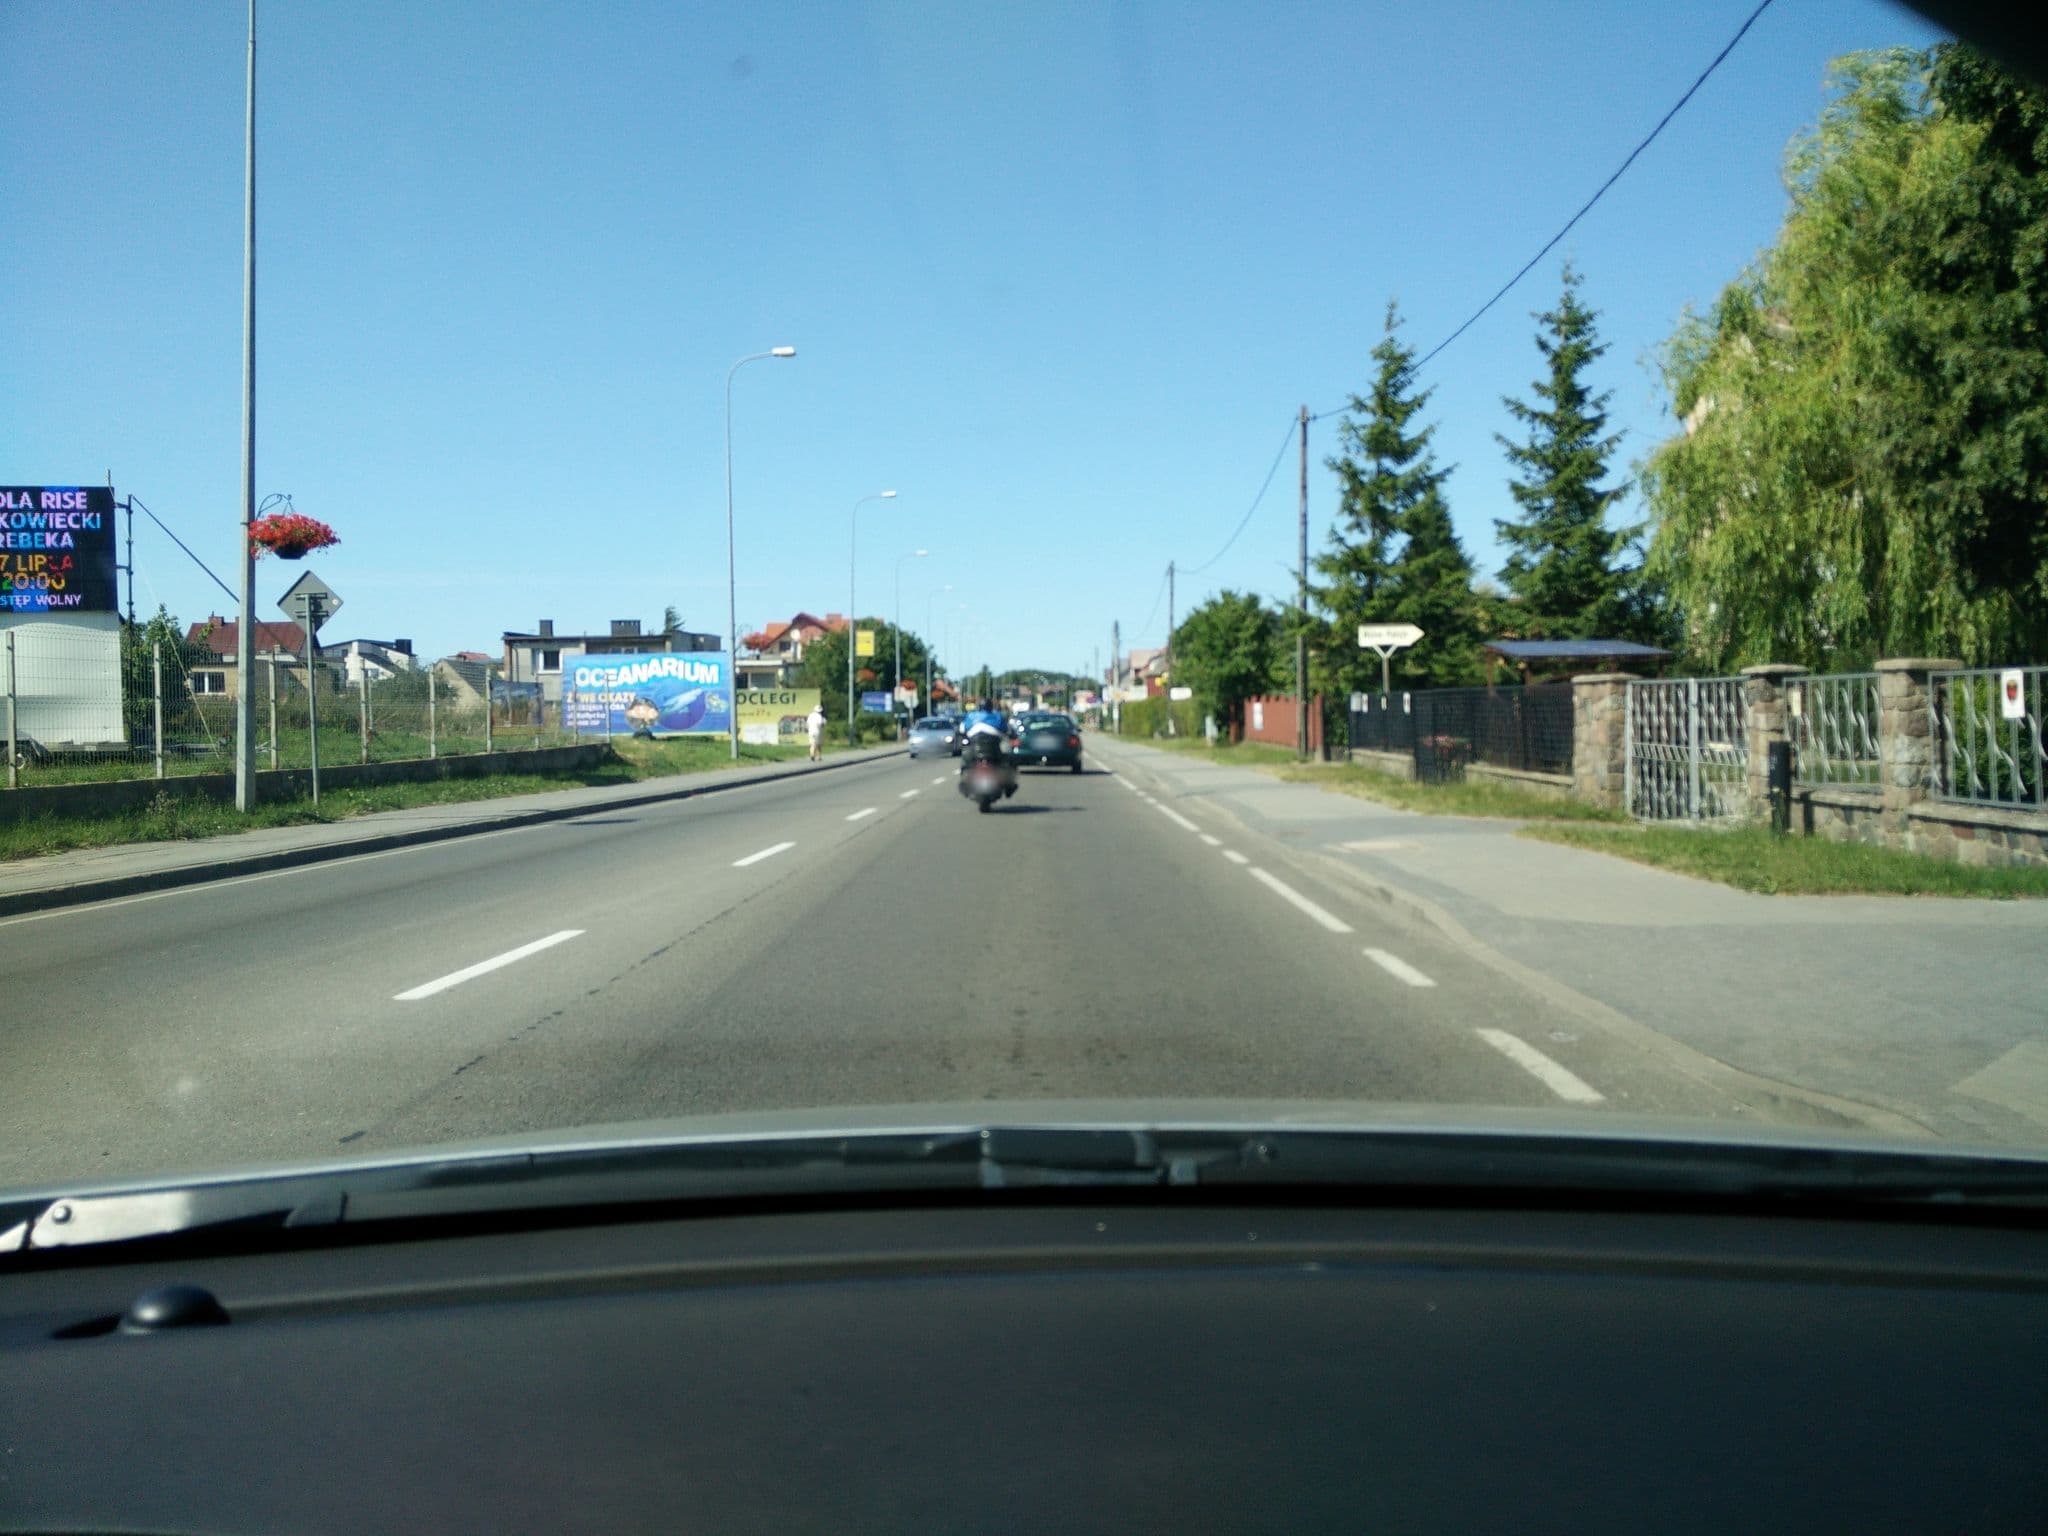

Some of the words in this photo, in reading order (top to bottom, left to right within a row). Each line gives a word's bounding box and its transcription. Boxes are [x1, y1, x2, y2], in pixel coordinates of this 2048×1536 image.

[41, 491, 87, 509] RISE
[0, 512, 101, 528] KOWIECKI
[0, 531, 74, 548] REBEKA
[0, 554, 10, 571] 7
[2, 572, 66, 589] 20:00
[35, 594, 82, 605] WOLNY
[576, 657, 719, 688] OCEANARIUM
[735, 692, 796, 705] OCLEGI
